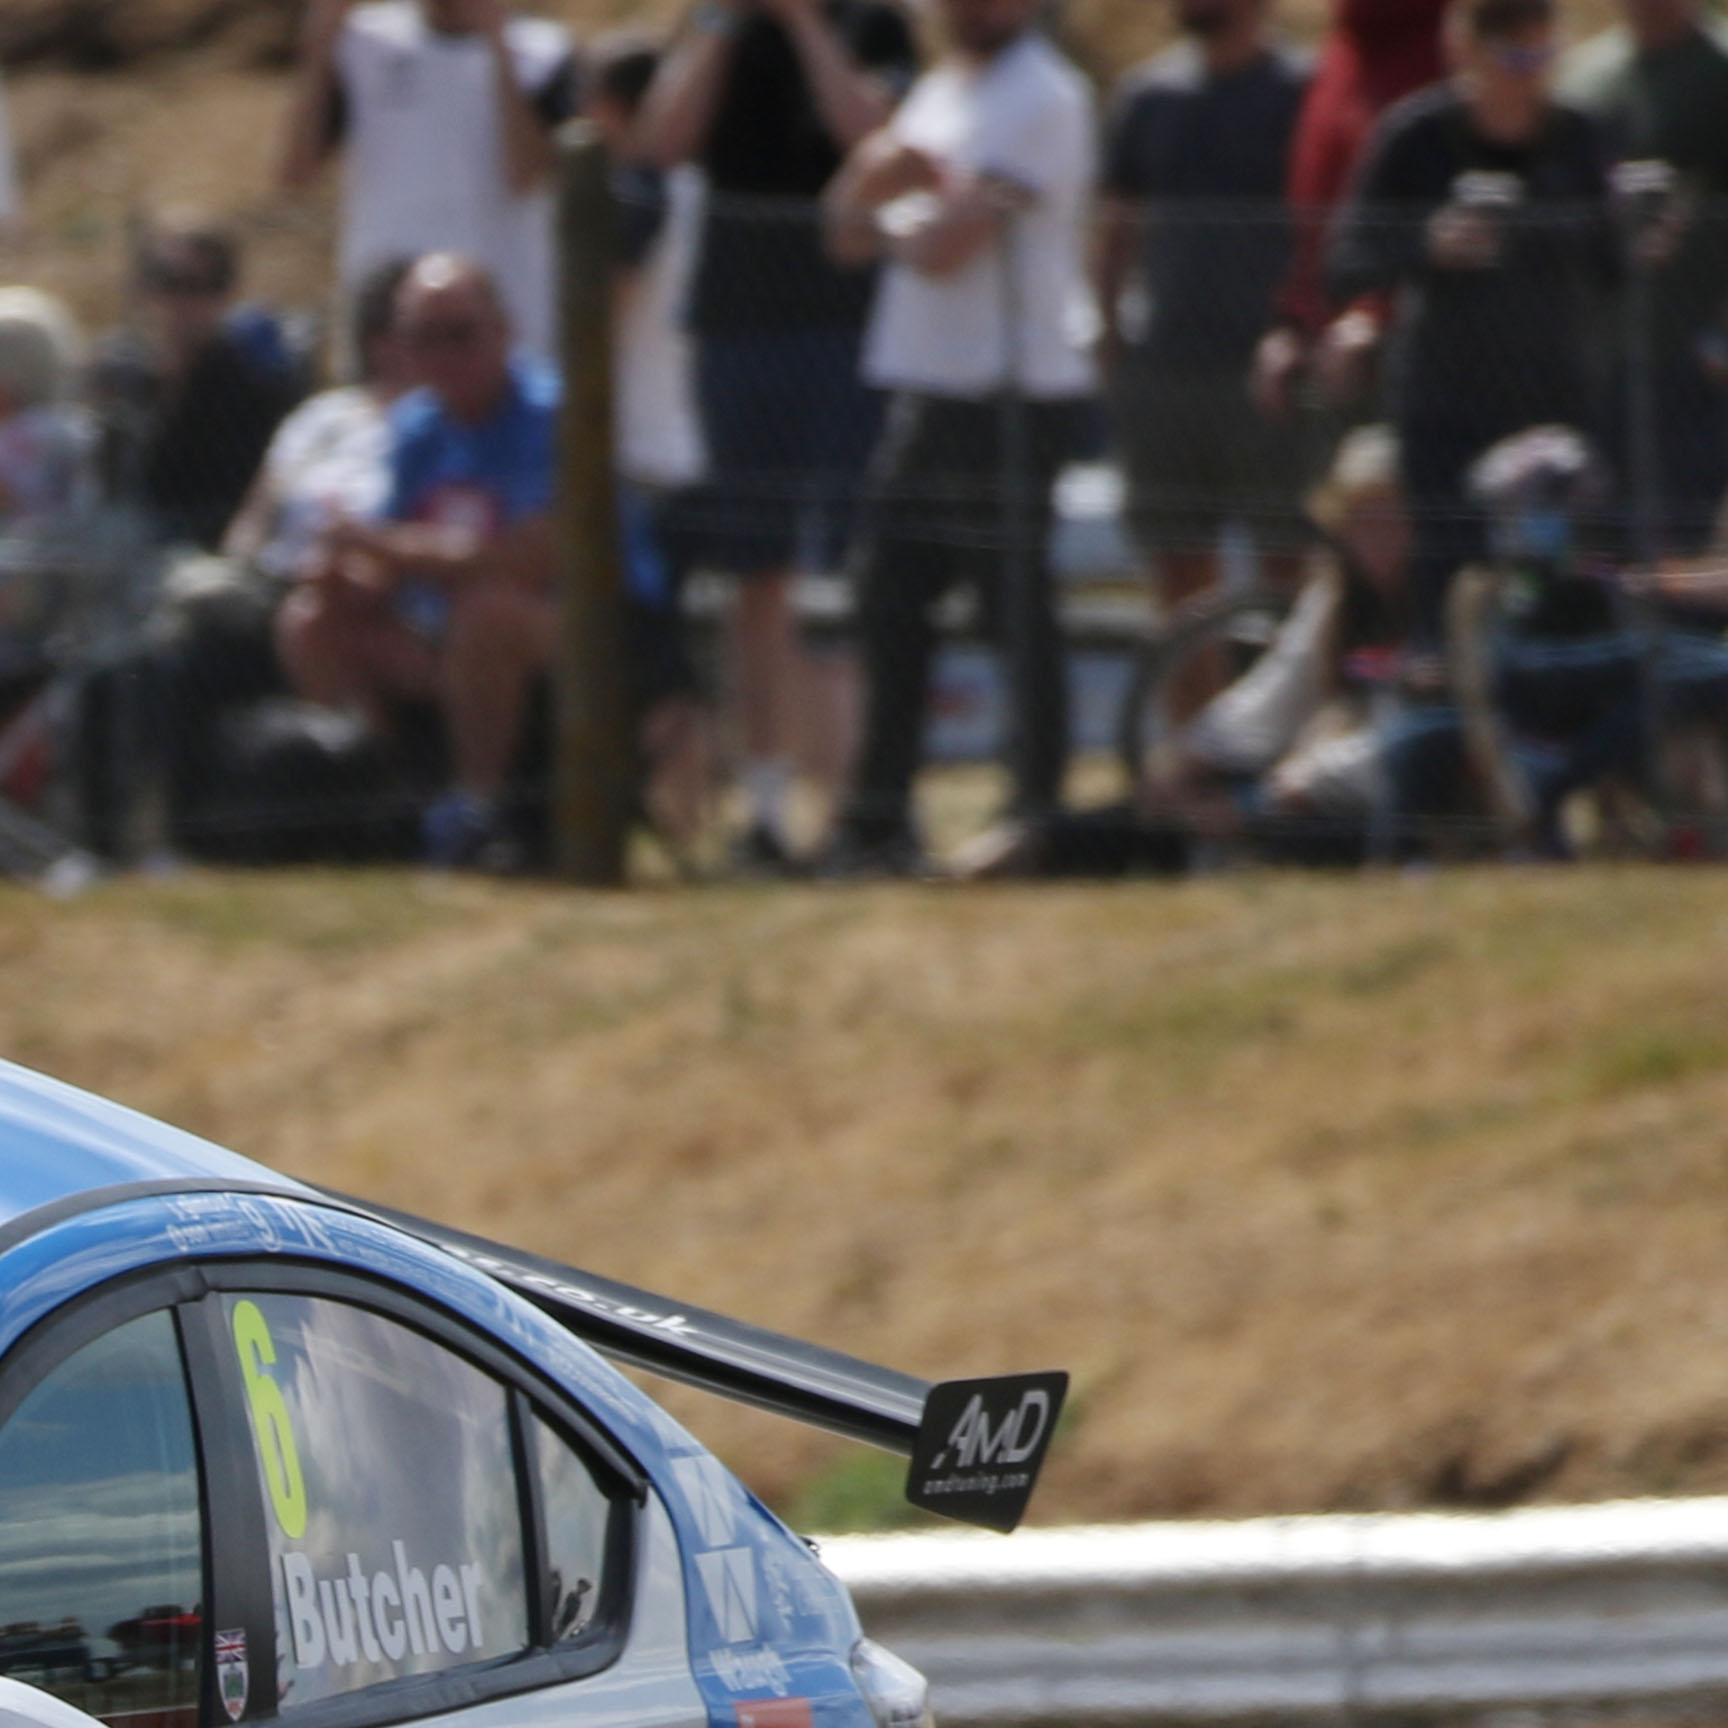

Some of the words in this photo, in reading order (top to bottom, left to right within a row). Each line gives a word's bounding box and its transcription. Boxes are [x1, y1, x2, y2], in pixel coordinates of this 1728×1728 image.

[231, 1299, 308, 1539] 6
[930, 1389, 1050, 1469] AMD
[281, 1540, 484, 1671] Butcher
